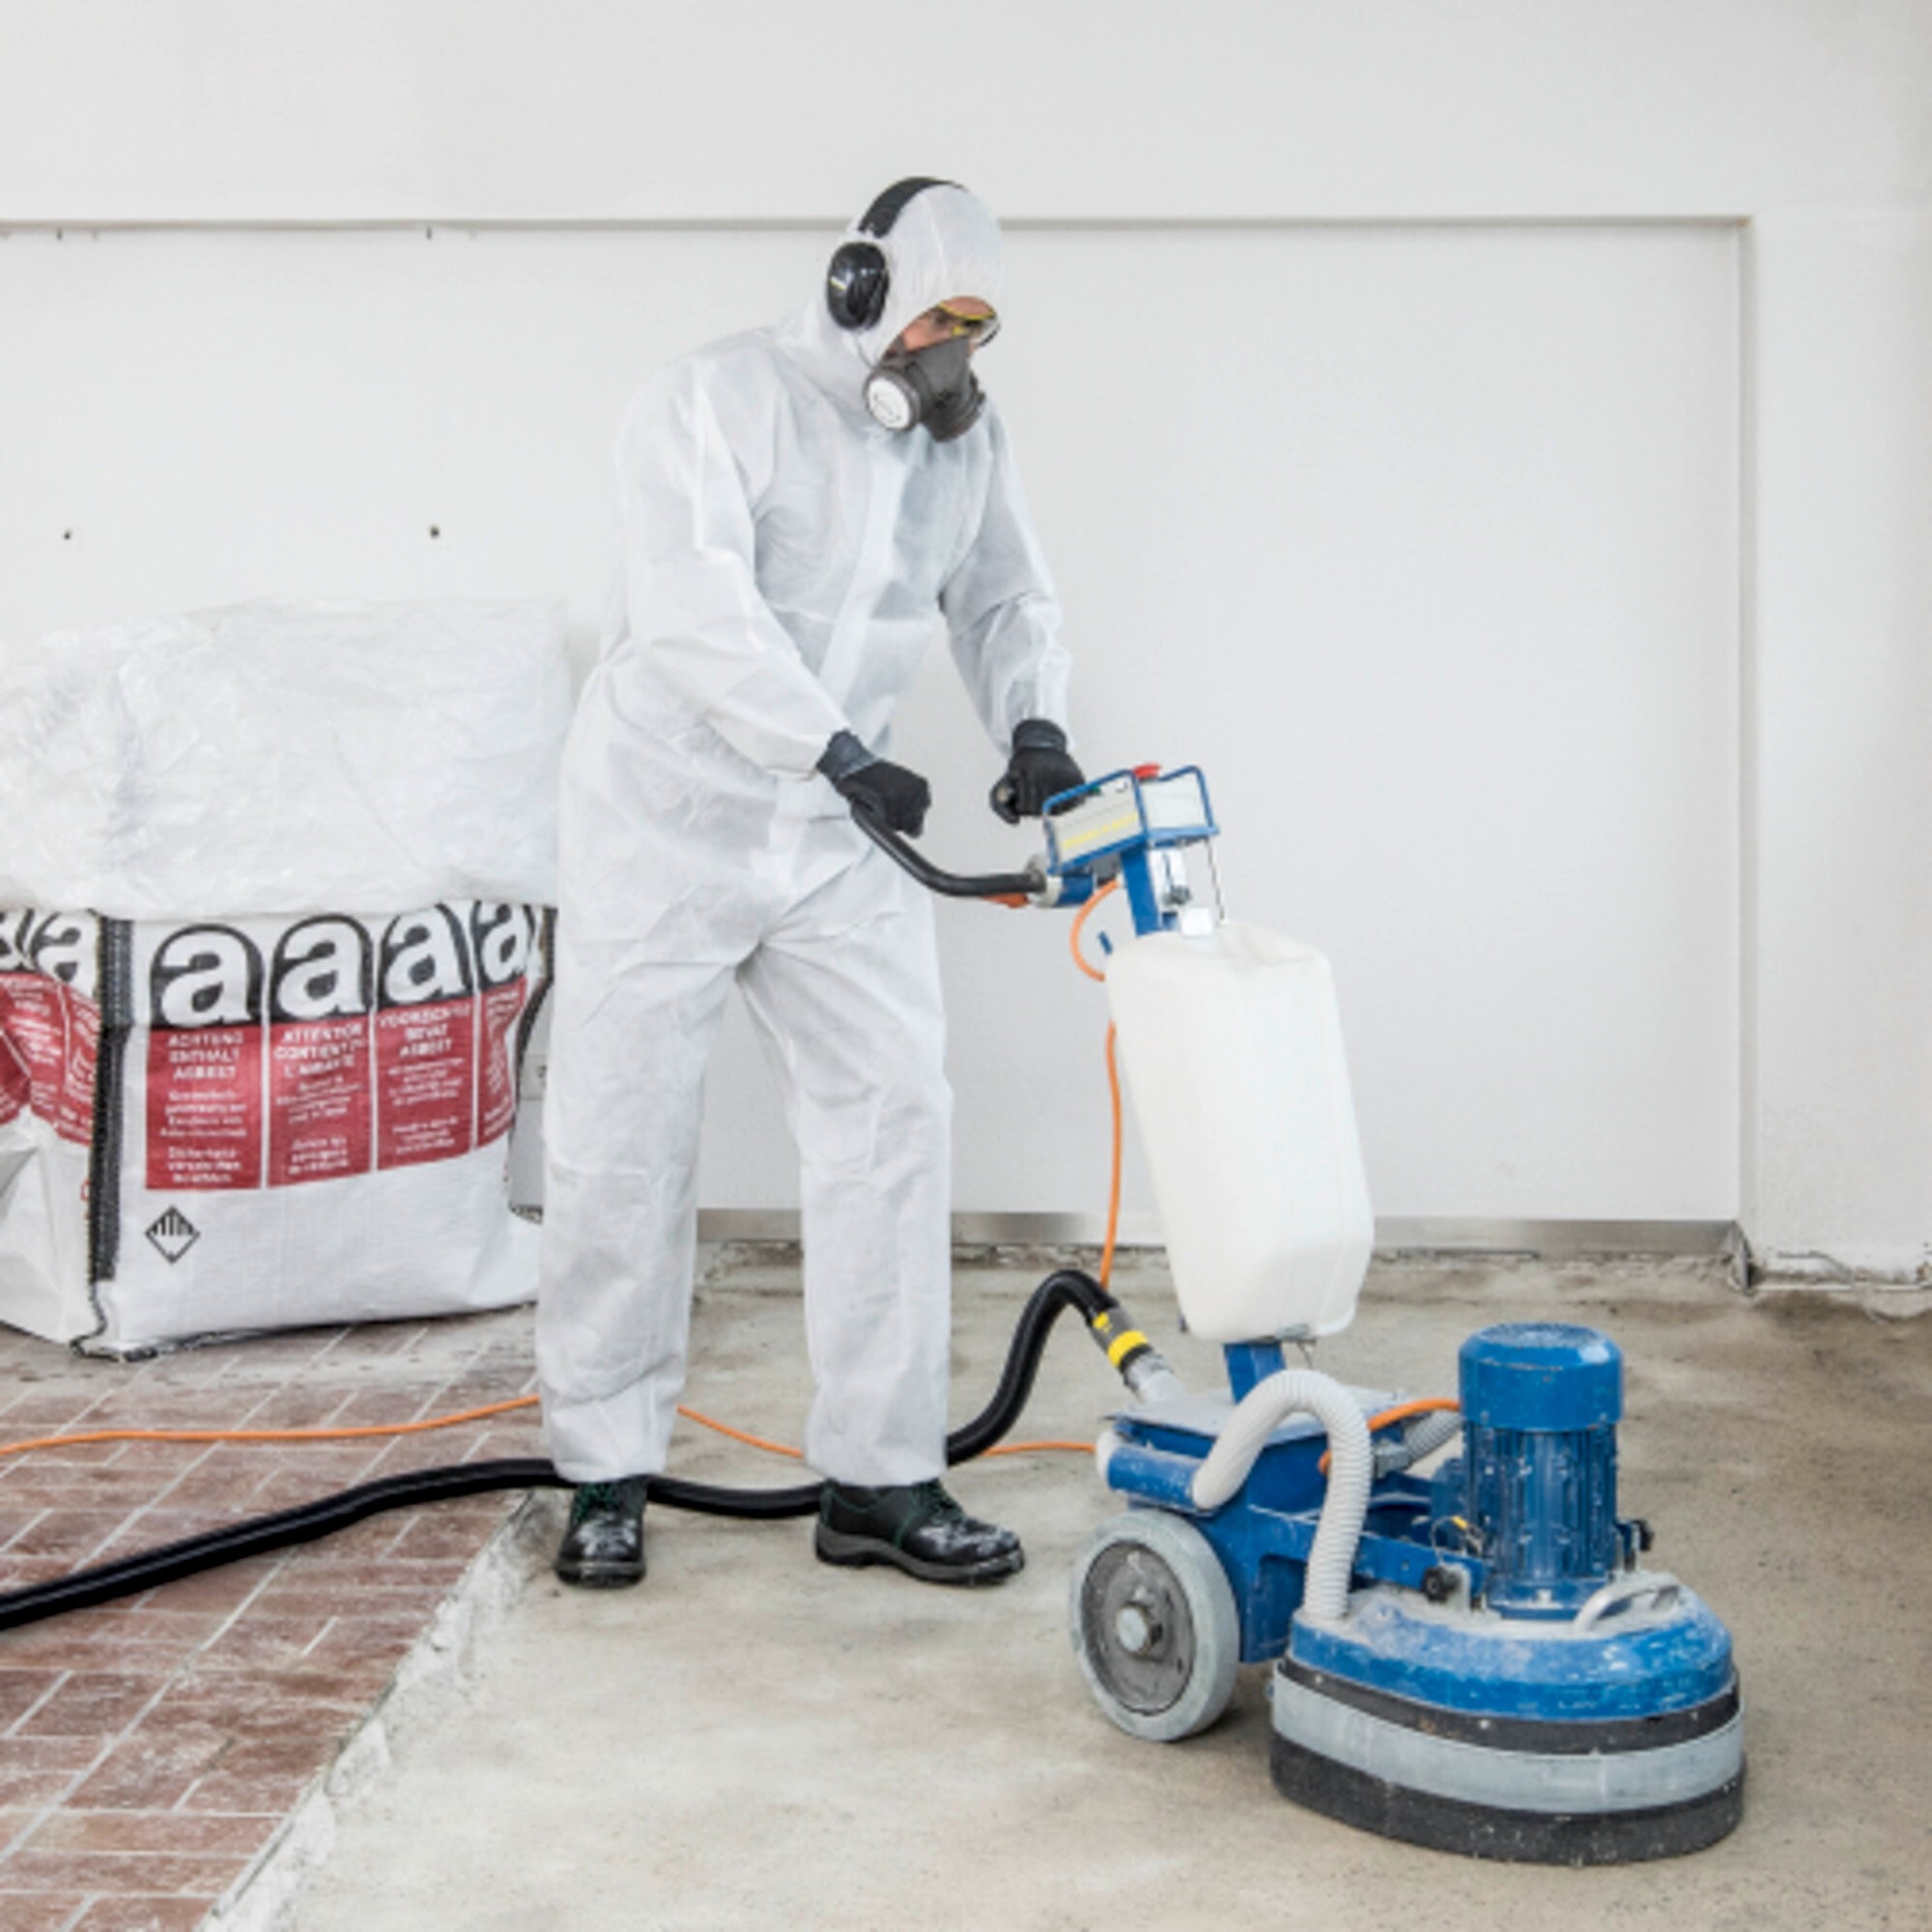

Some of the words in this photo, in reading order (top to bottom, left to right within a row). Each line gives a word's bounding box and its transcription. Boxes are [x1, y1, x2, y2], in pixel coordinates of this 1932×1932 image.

[160, 930, 253, 1029] a
[277, 922, 366, 1018] a
[386, 905, 467, 1006] a
[482, 902, 530, 983] a
[167, 1030, 244, 1047] ACHTUNG
